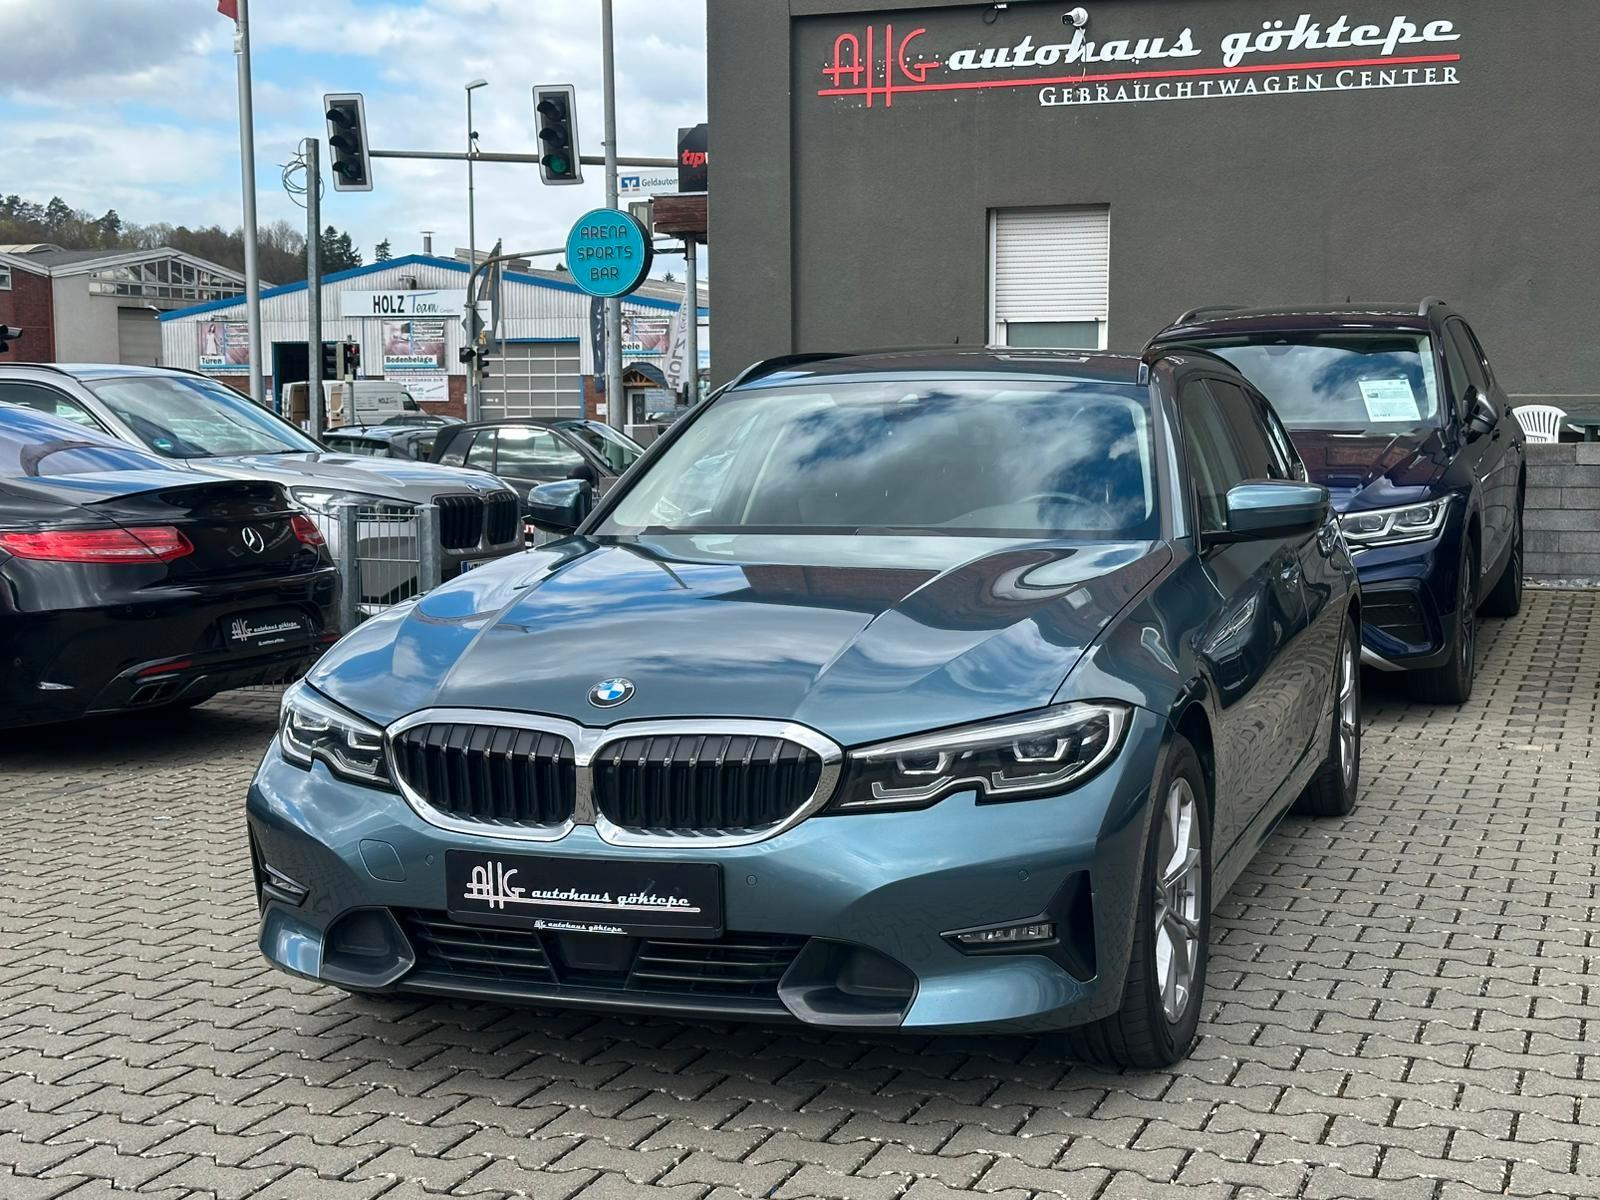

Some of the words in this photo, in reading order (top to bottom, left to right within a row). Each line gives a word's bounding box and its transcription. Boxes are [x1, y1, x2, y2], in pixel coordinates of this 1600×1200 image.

[949, 28, 1201, 71] autohaus
[1220, 14, 1461, 67] göktepe
[1038, 73, 1323, 106] GEBRAUCHTWAGEN
[1335, 66, 1460, 89] CENTER
[682, 149, 708, 168] tip
[580, 224, 628, 240] ARENA
[577, 245, 633, 261] SPORTS
[590, 266, 620, 281] BAR
[373, 295, 405, 313] HOLZ
[407, 291, 438, 313] Team
[532, 887, 612, 903] autohaus
[617, 892, 691, 908] göktepe
[548, 922, 586, 930] autohaus
